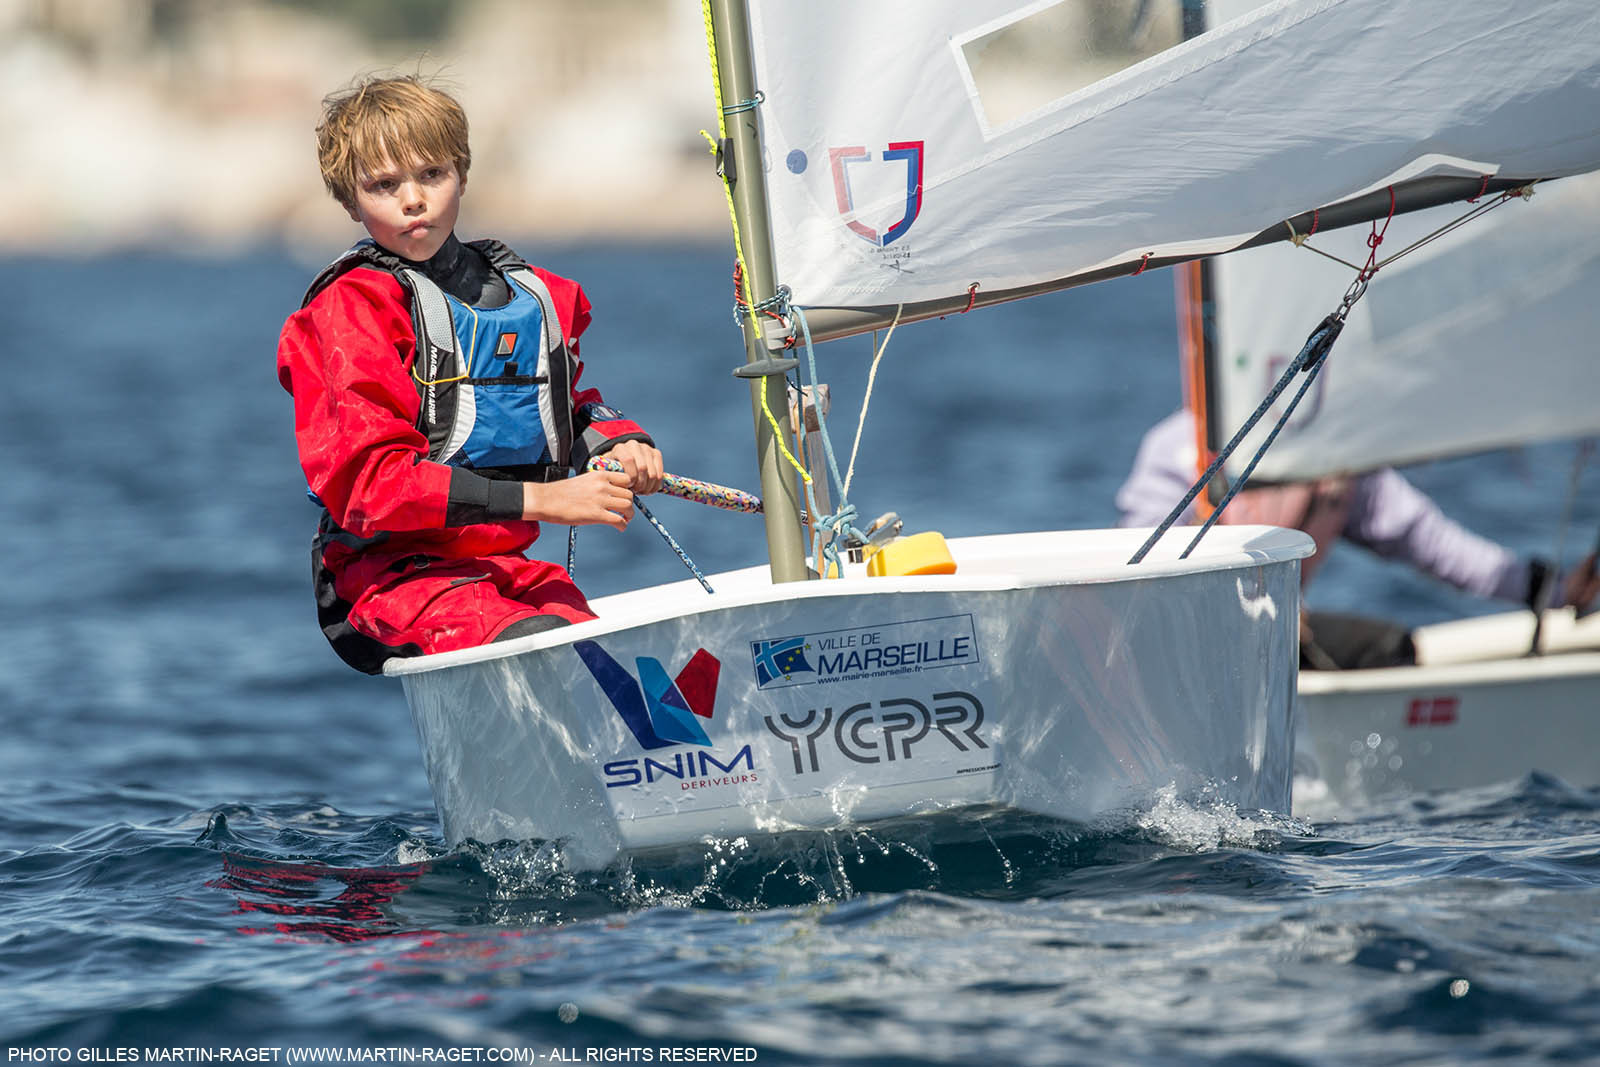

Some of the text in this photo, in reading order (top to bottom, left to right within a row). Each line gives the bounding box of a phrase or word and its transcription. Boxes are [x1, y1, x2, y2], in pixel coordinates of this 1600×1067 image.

[428, 384, 437, 425] MARINE
[817, 636, 970, 676] MARSEILLE
[818, 632, 881, 650] VILLE DE
[818, 665, 923, 685] www.mairie-marseille.fr
[764, 691, 990, 774] YCPR
[603, 744, 755, 788] SNIM
[681, 773, 758, 791] DERIVEURS
